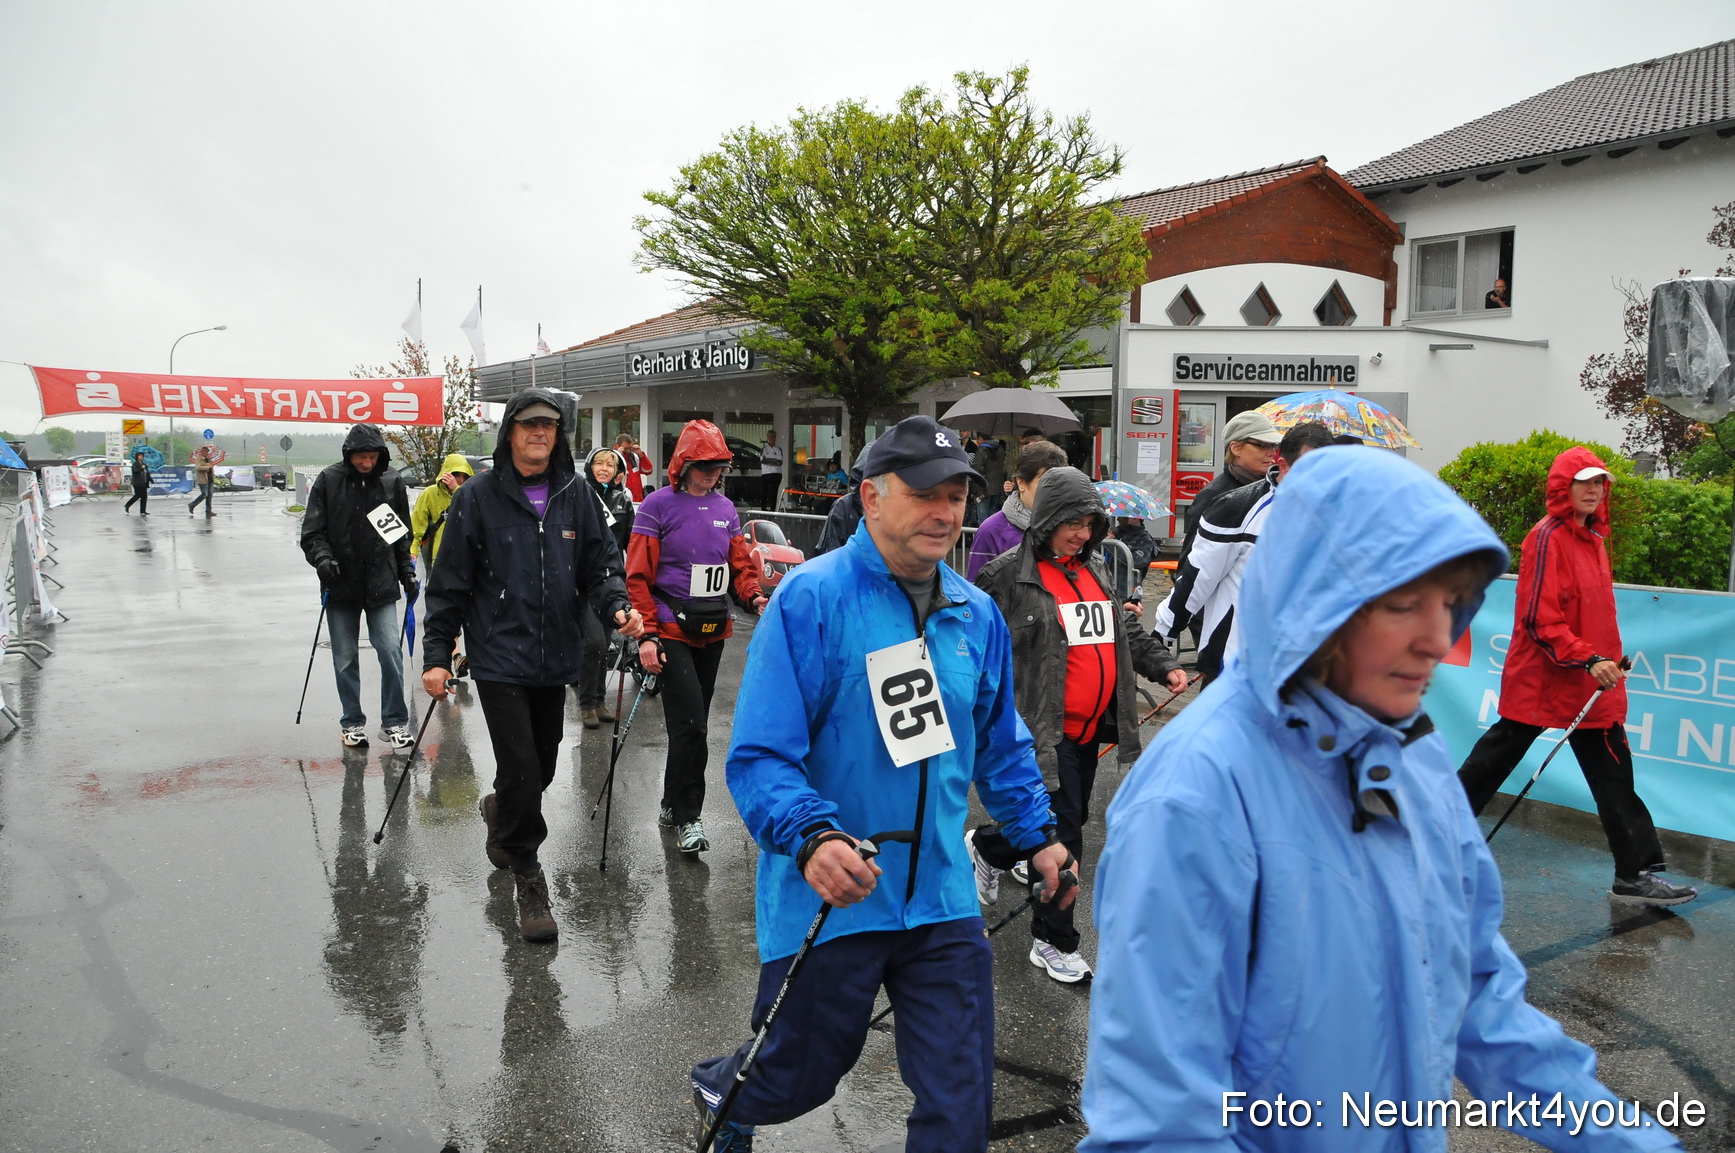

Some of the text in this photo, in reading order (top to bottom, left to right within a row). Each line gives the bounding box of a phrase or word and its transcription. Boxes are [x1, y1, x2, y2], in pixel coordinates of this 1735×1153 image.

[631, 341, 749, 376] Gerhart & Jänig
[1175, 355, 1356, 383] Serviceannahme
[935, 432, 952, 447] &
[1125, 431, 1169, 439] SEAT
[376, 512, 403, 535] 37
[704, 566, 725, 593] 10
[701, 623, 718, 633] CAT
[1075, 602, 1106, 638] 20
[880, 667, 945, 741] 65
